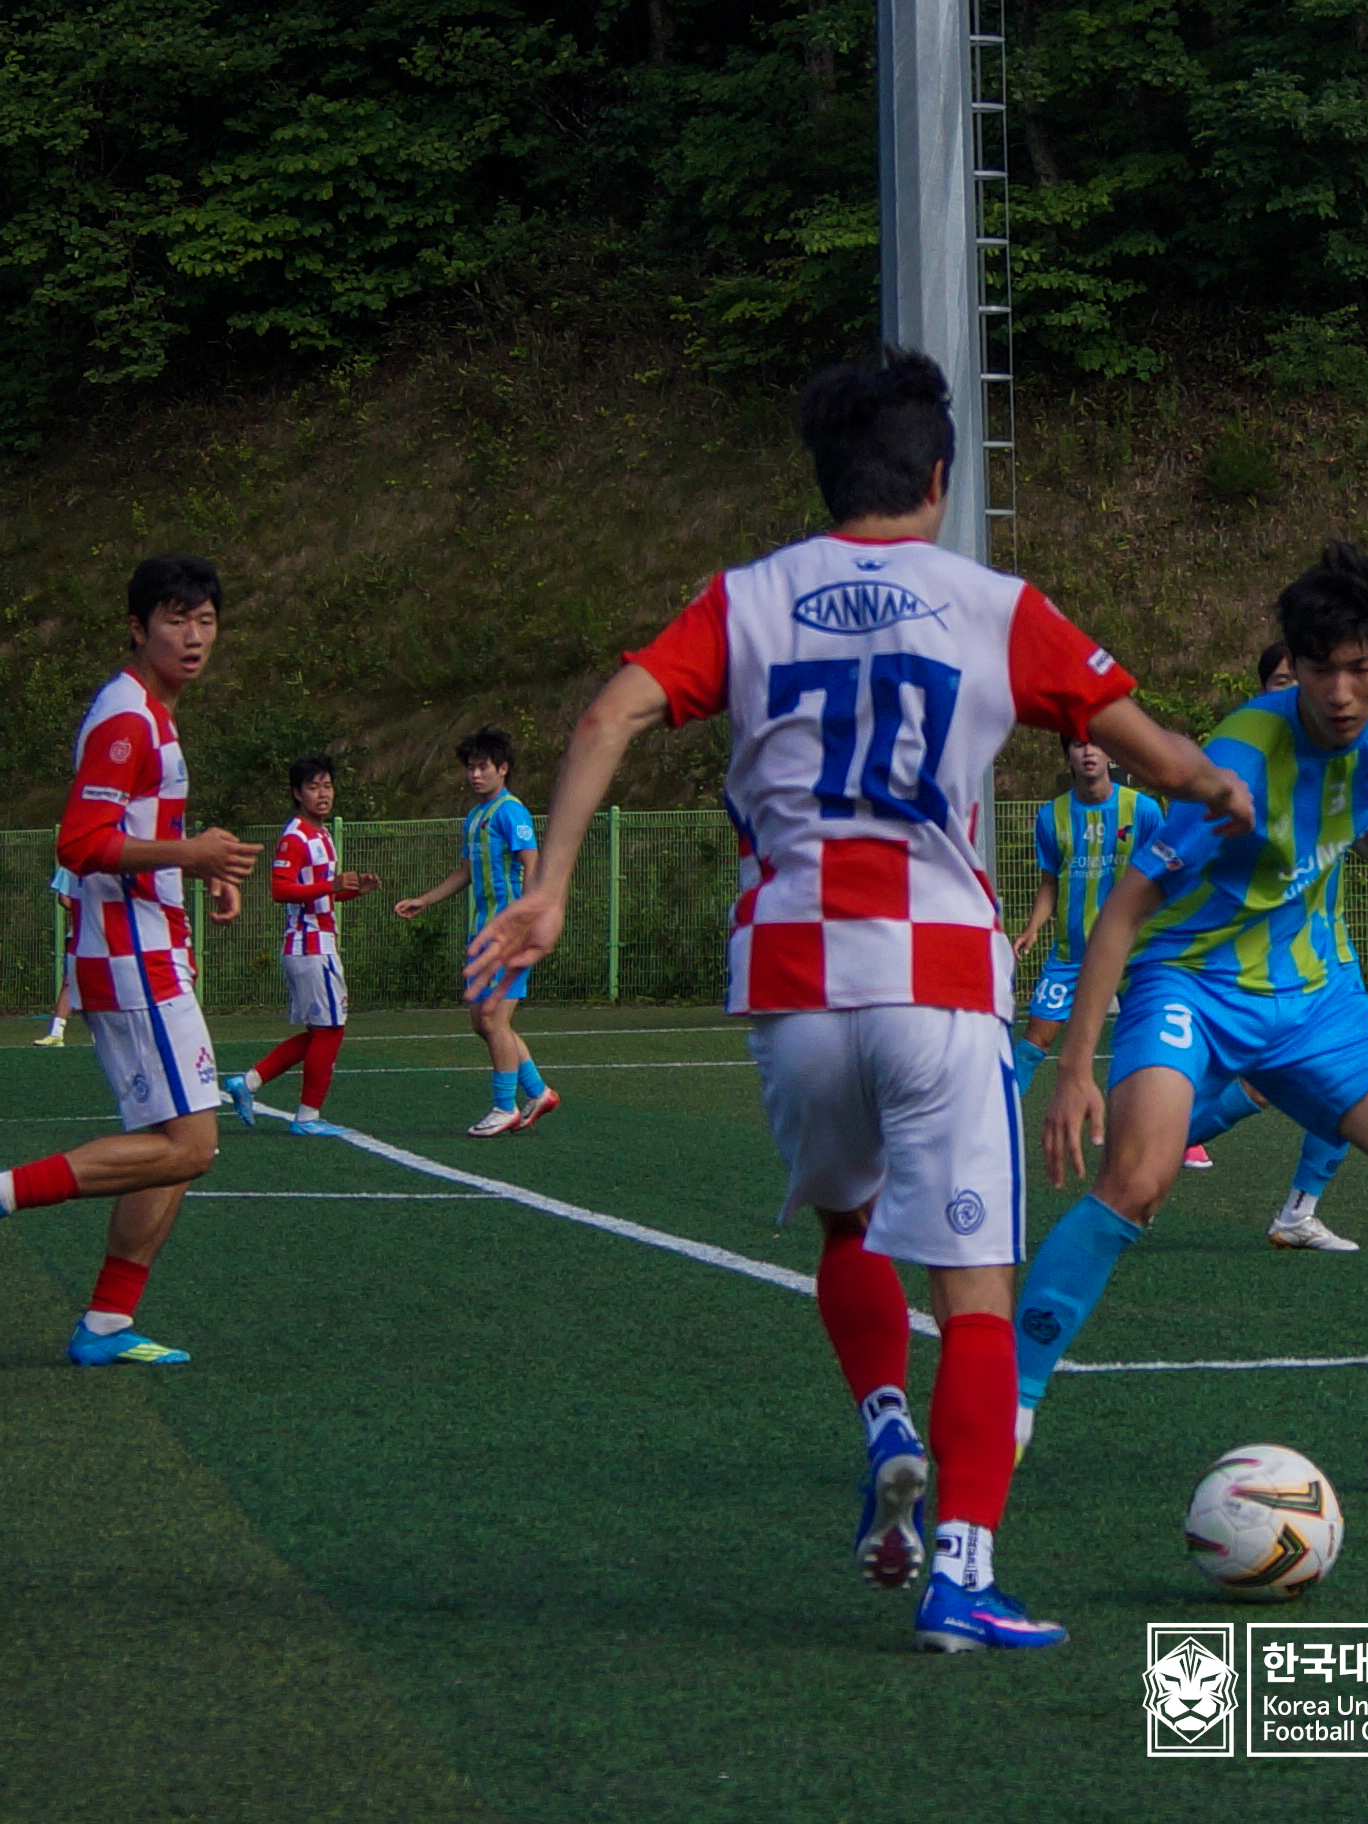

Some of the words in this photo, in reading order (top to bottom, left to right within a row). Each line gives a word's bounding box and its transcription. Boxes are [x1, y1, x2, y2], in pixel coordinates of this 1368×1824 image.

[803, 583, 920, 628] HANNAM
[767, 653, 962, 832] 70
[1083, 822, 1105, 845] 49
[1035, 978, 1068, 1009] 49
[1159, 1003, 1193, 1049] 3
